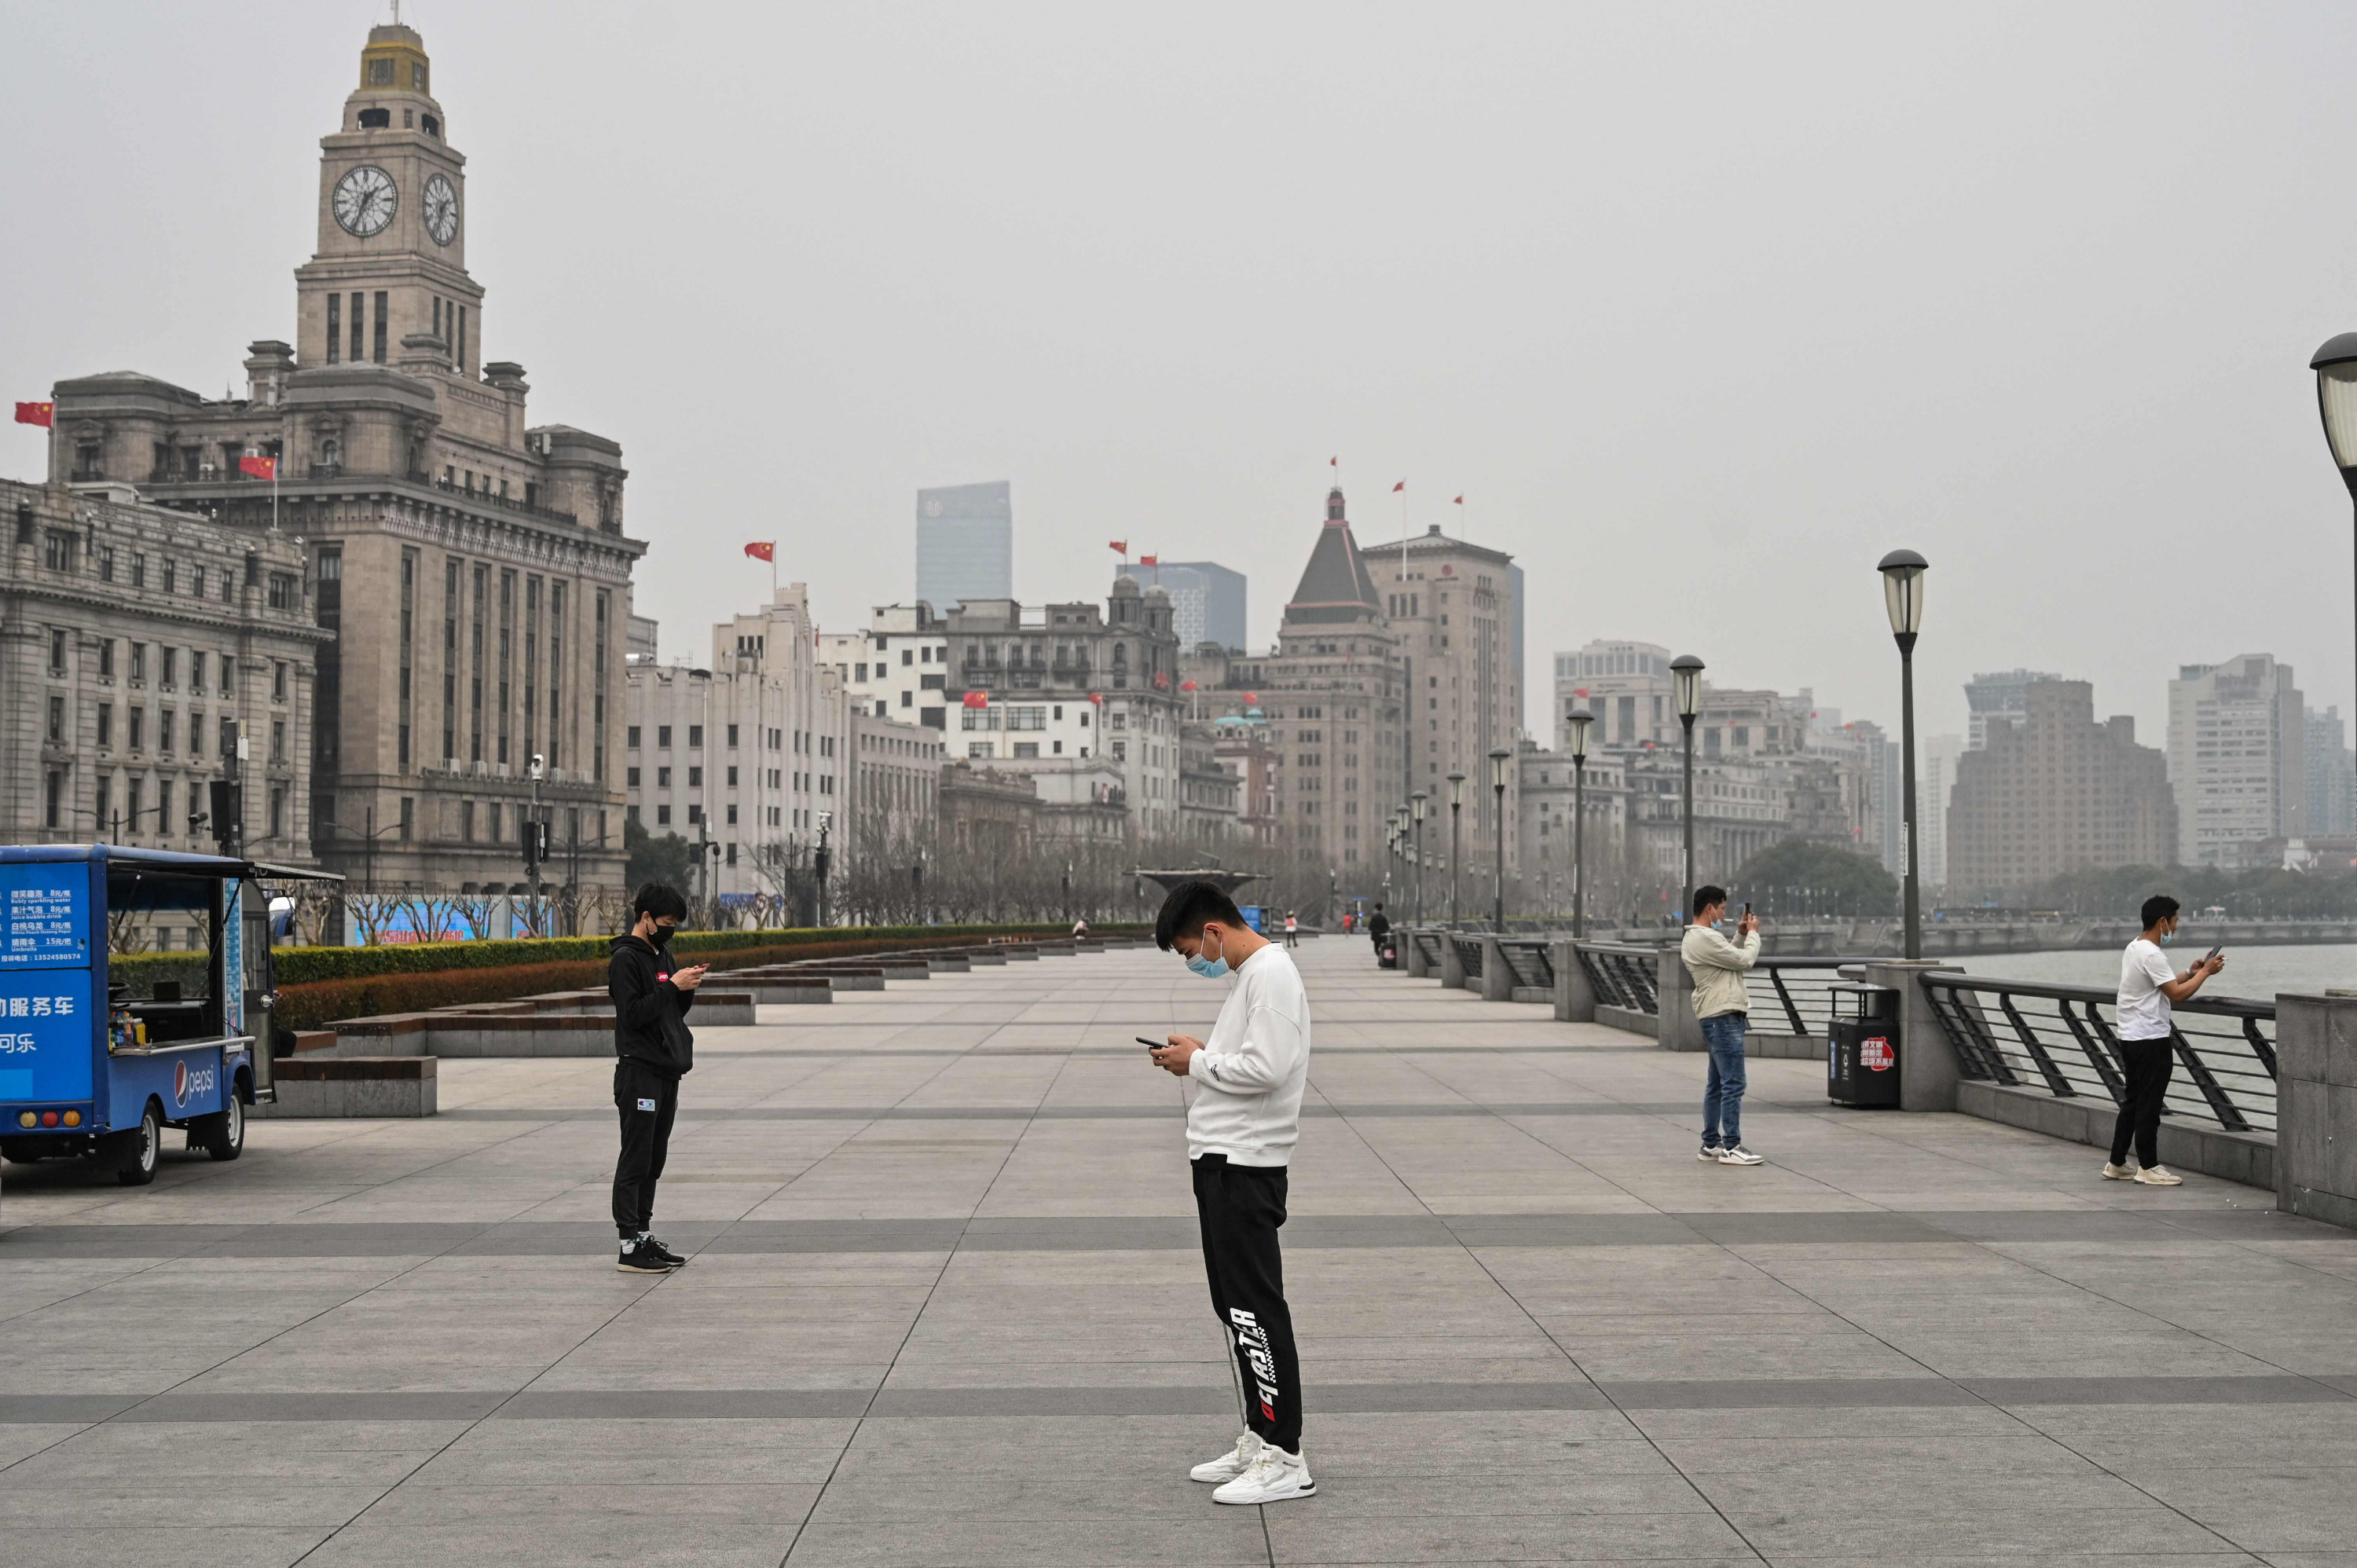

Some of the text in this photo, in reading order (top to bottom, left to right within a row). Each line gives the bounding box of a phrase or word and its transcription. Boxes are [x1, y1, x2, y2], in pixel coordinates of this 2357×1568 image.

[12, 921, 43, 930] 白桃乌龙
[0, 1033, 36, 1053] 可乐
[189, 1064, 214, 1100] pepsi
